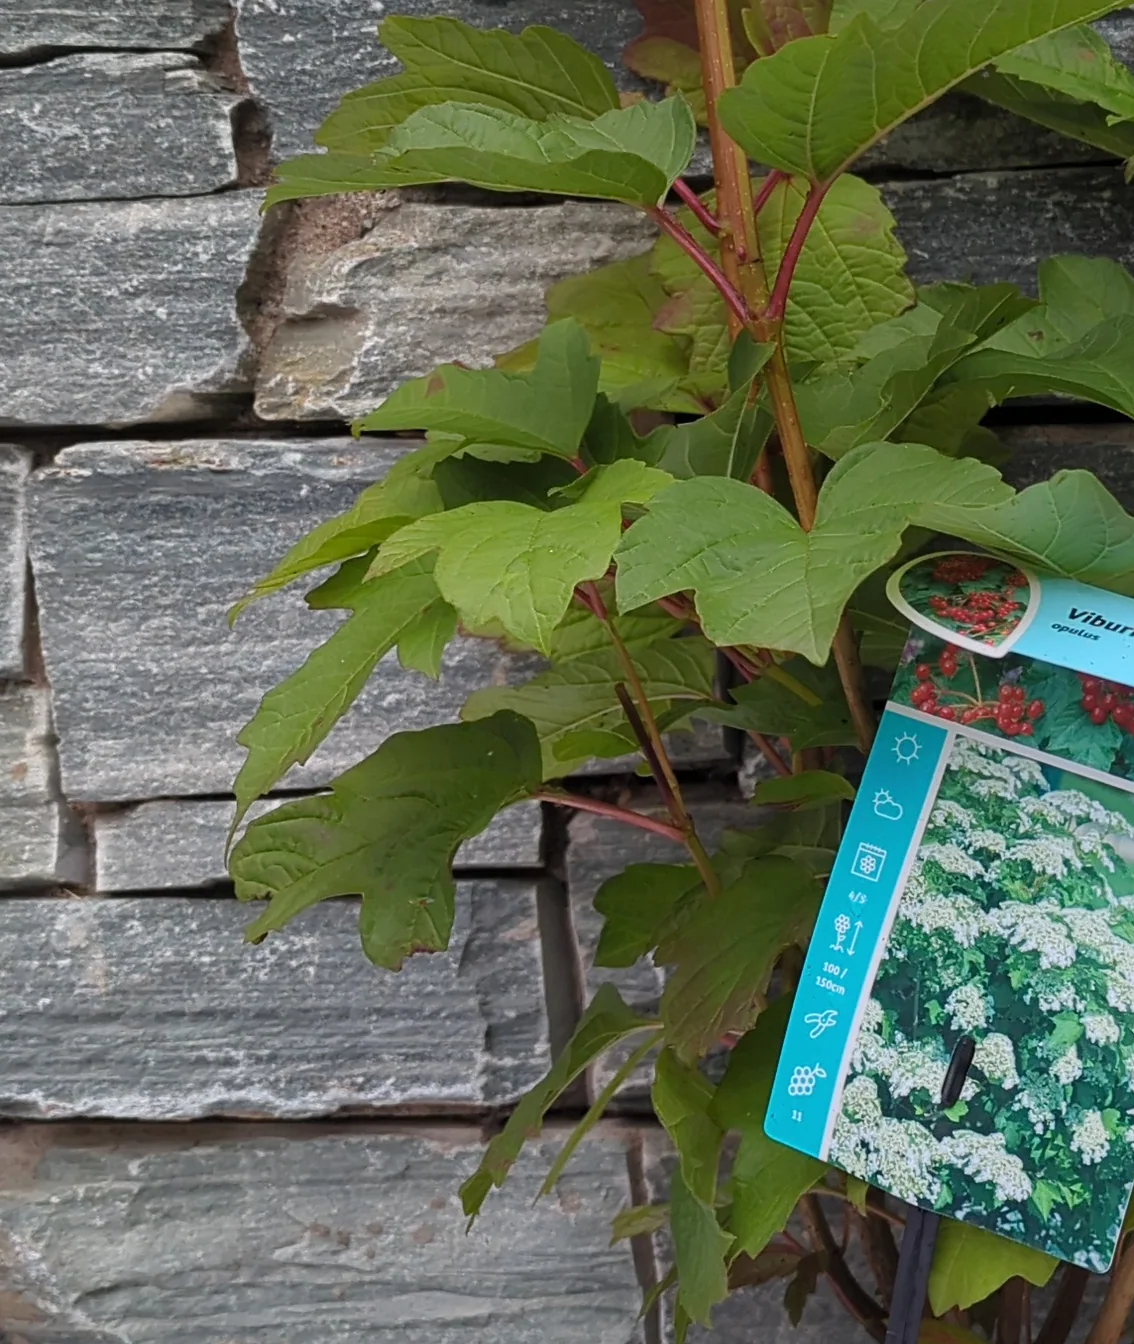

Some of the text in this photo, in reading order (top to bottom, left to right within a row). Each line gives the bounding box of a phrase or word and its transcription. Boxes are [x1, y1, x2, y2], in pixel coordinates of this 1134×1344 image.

[1051, 623, 1100, 641] opulus
[823, 962, 840, 976] 100
[816, 976, 846, 995] 150cm
